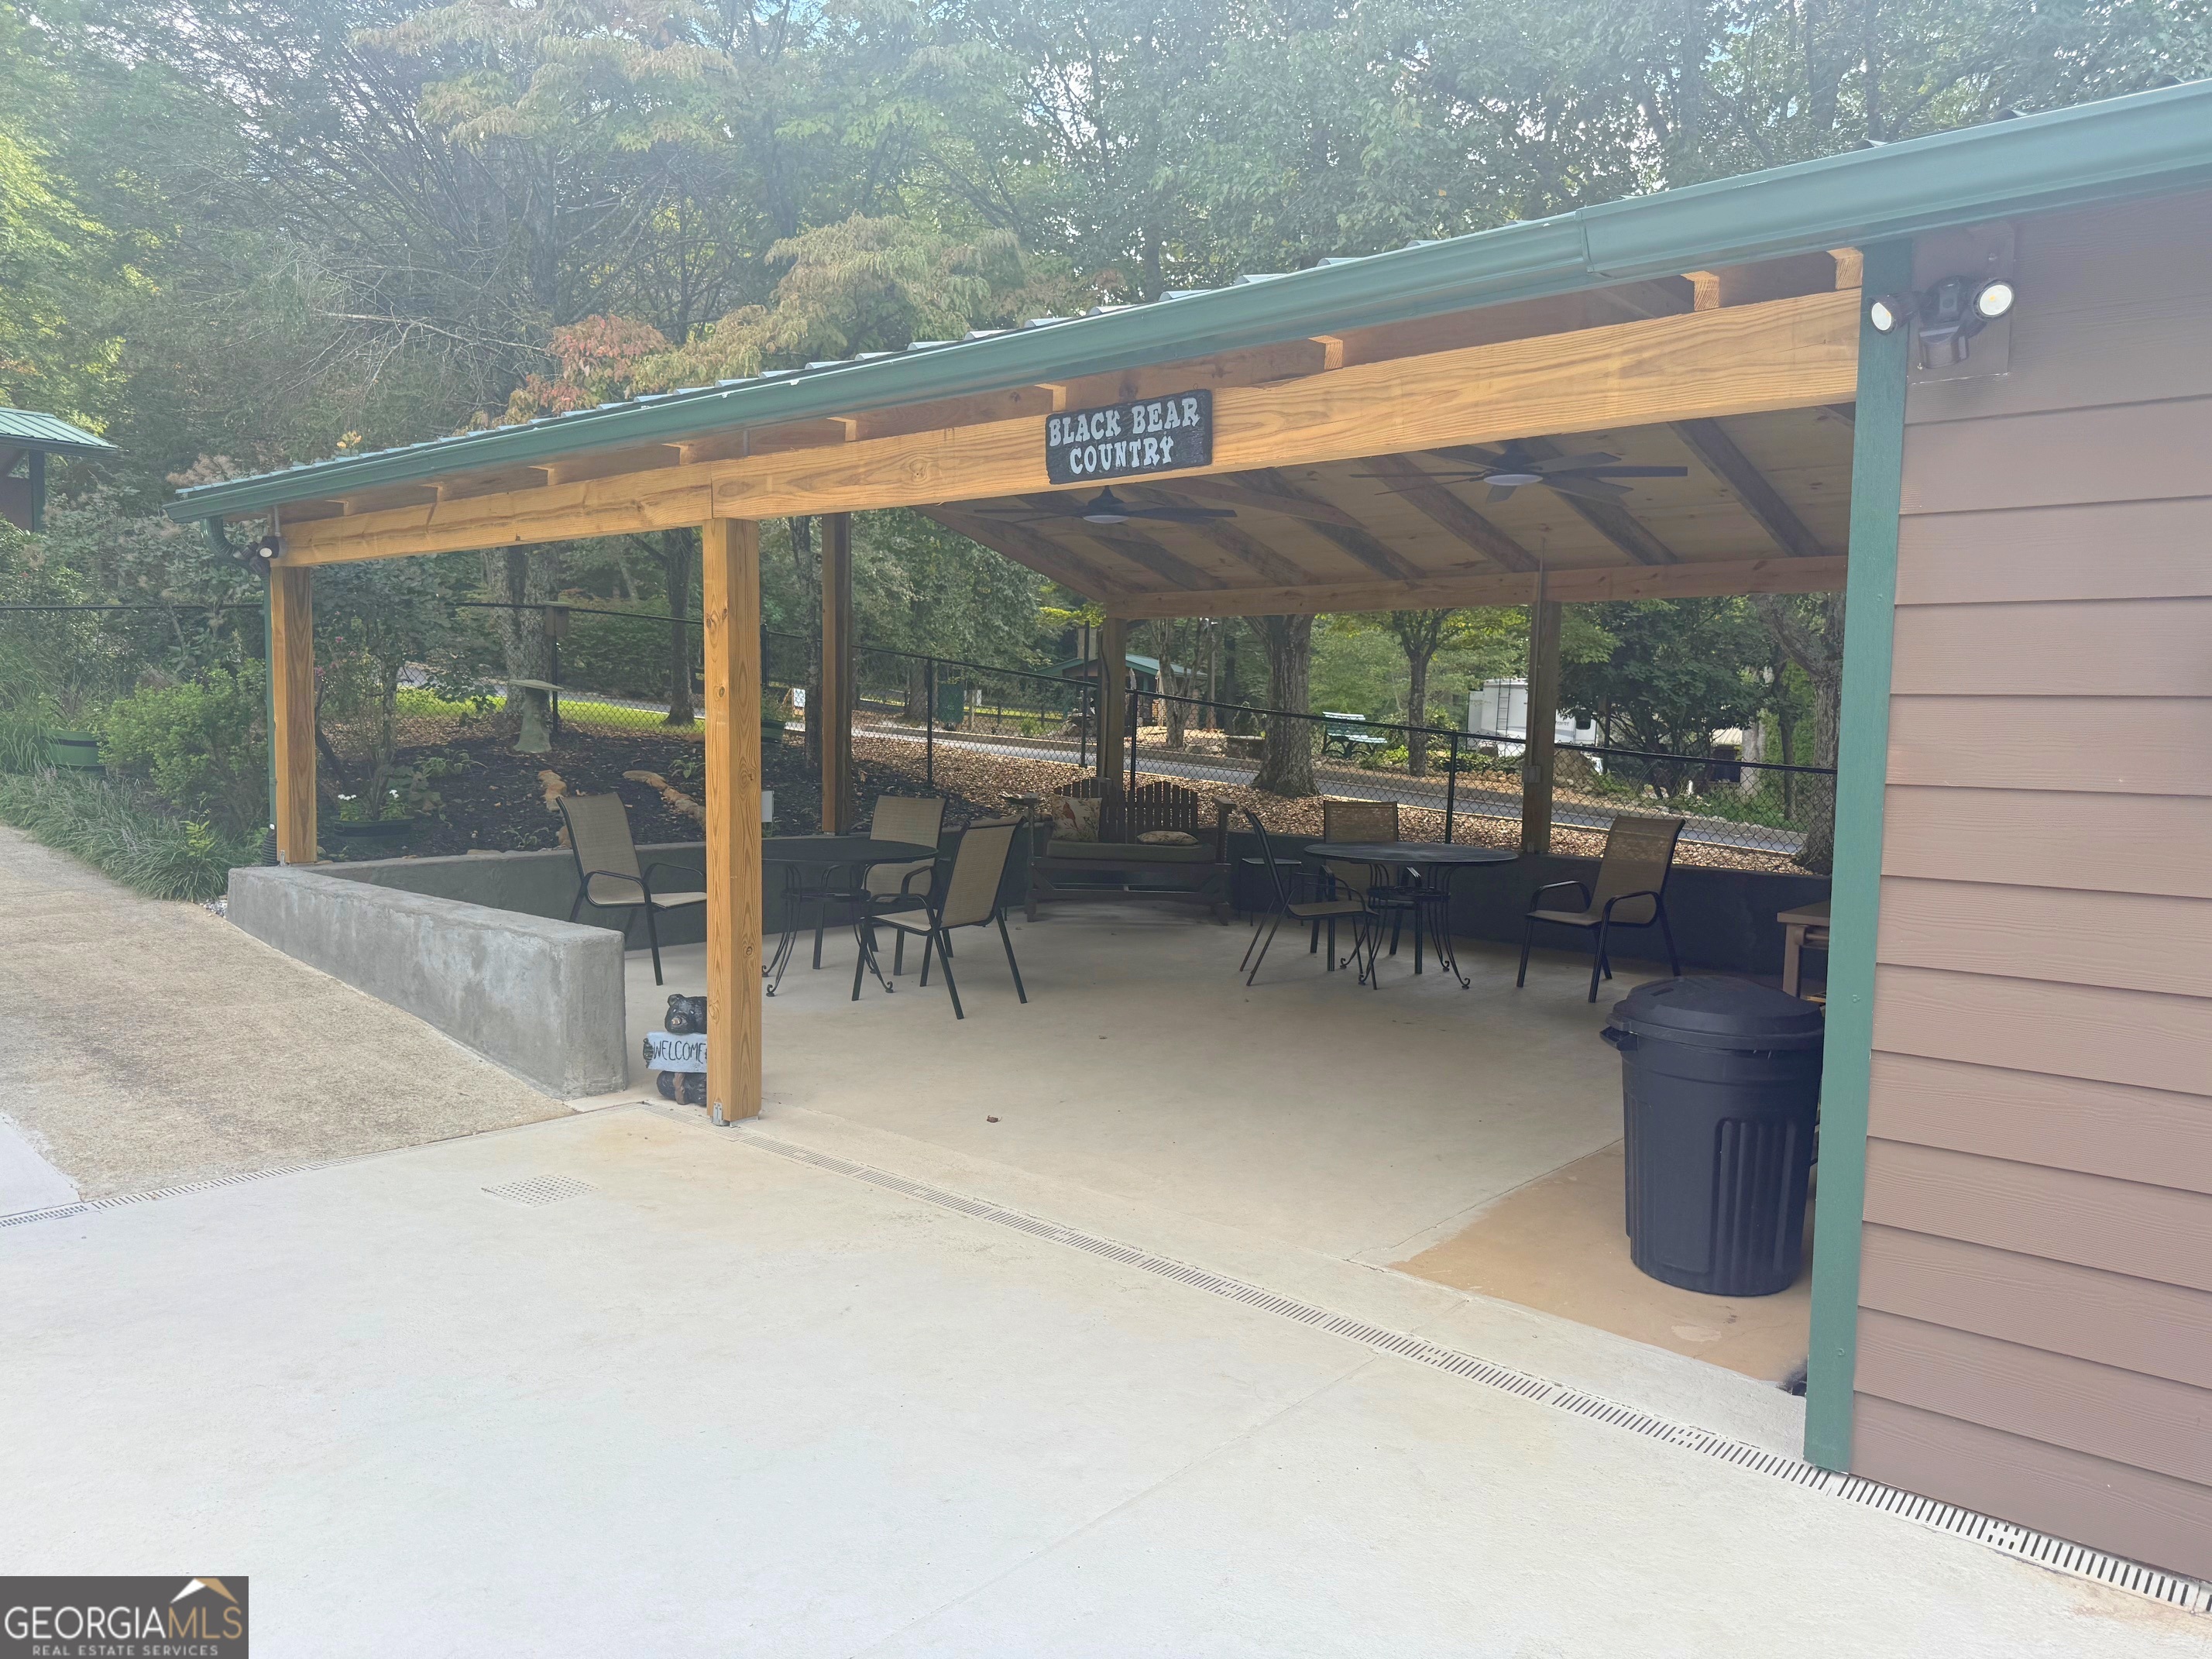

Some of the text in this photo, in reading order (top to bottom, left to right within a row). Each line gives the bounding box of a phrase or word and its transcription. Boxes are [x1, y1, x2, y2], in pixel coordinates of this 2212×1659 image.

[1049, 397, 1200, 447] BLACK BEAR
[1070, 434, 1174, 475] COUNTRY
[653, 1040, 706, 1064] WELCOME
